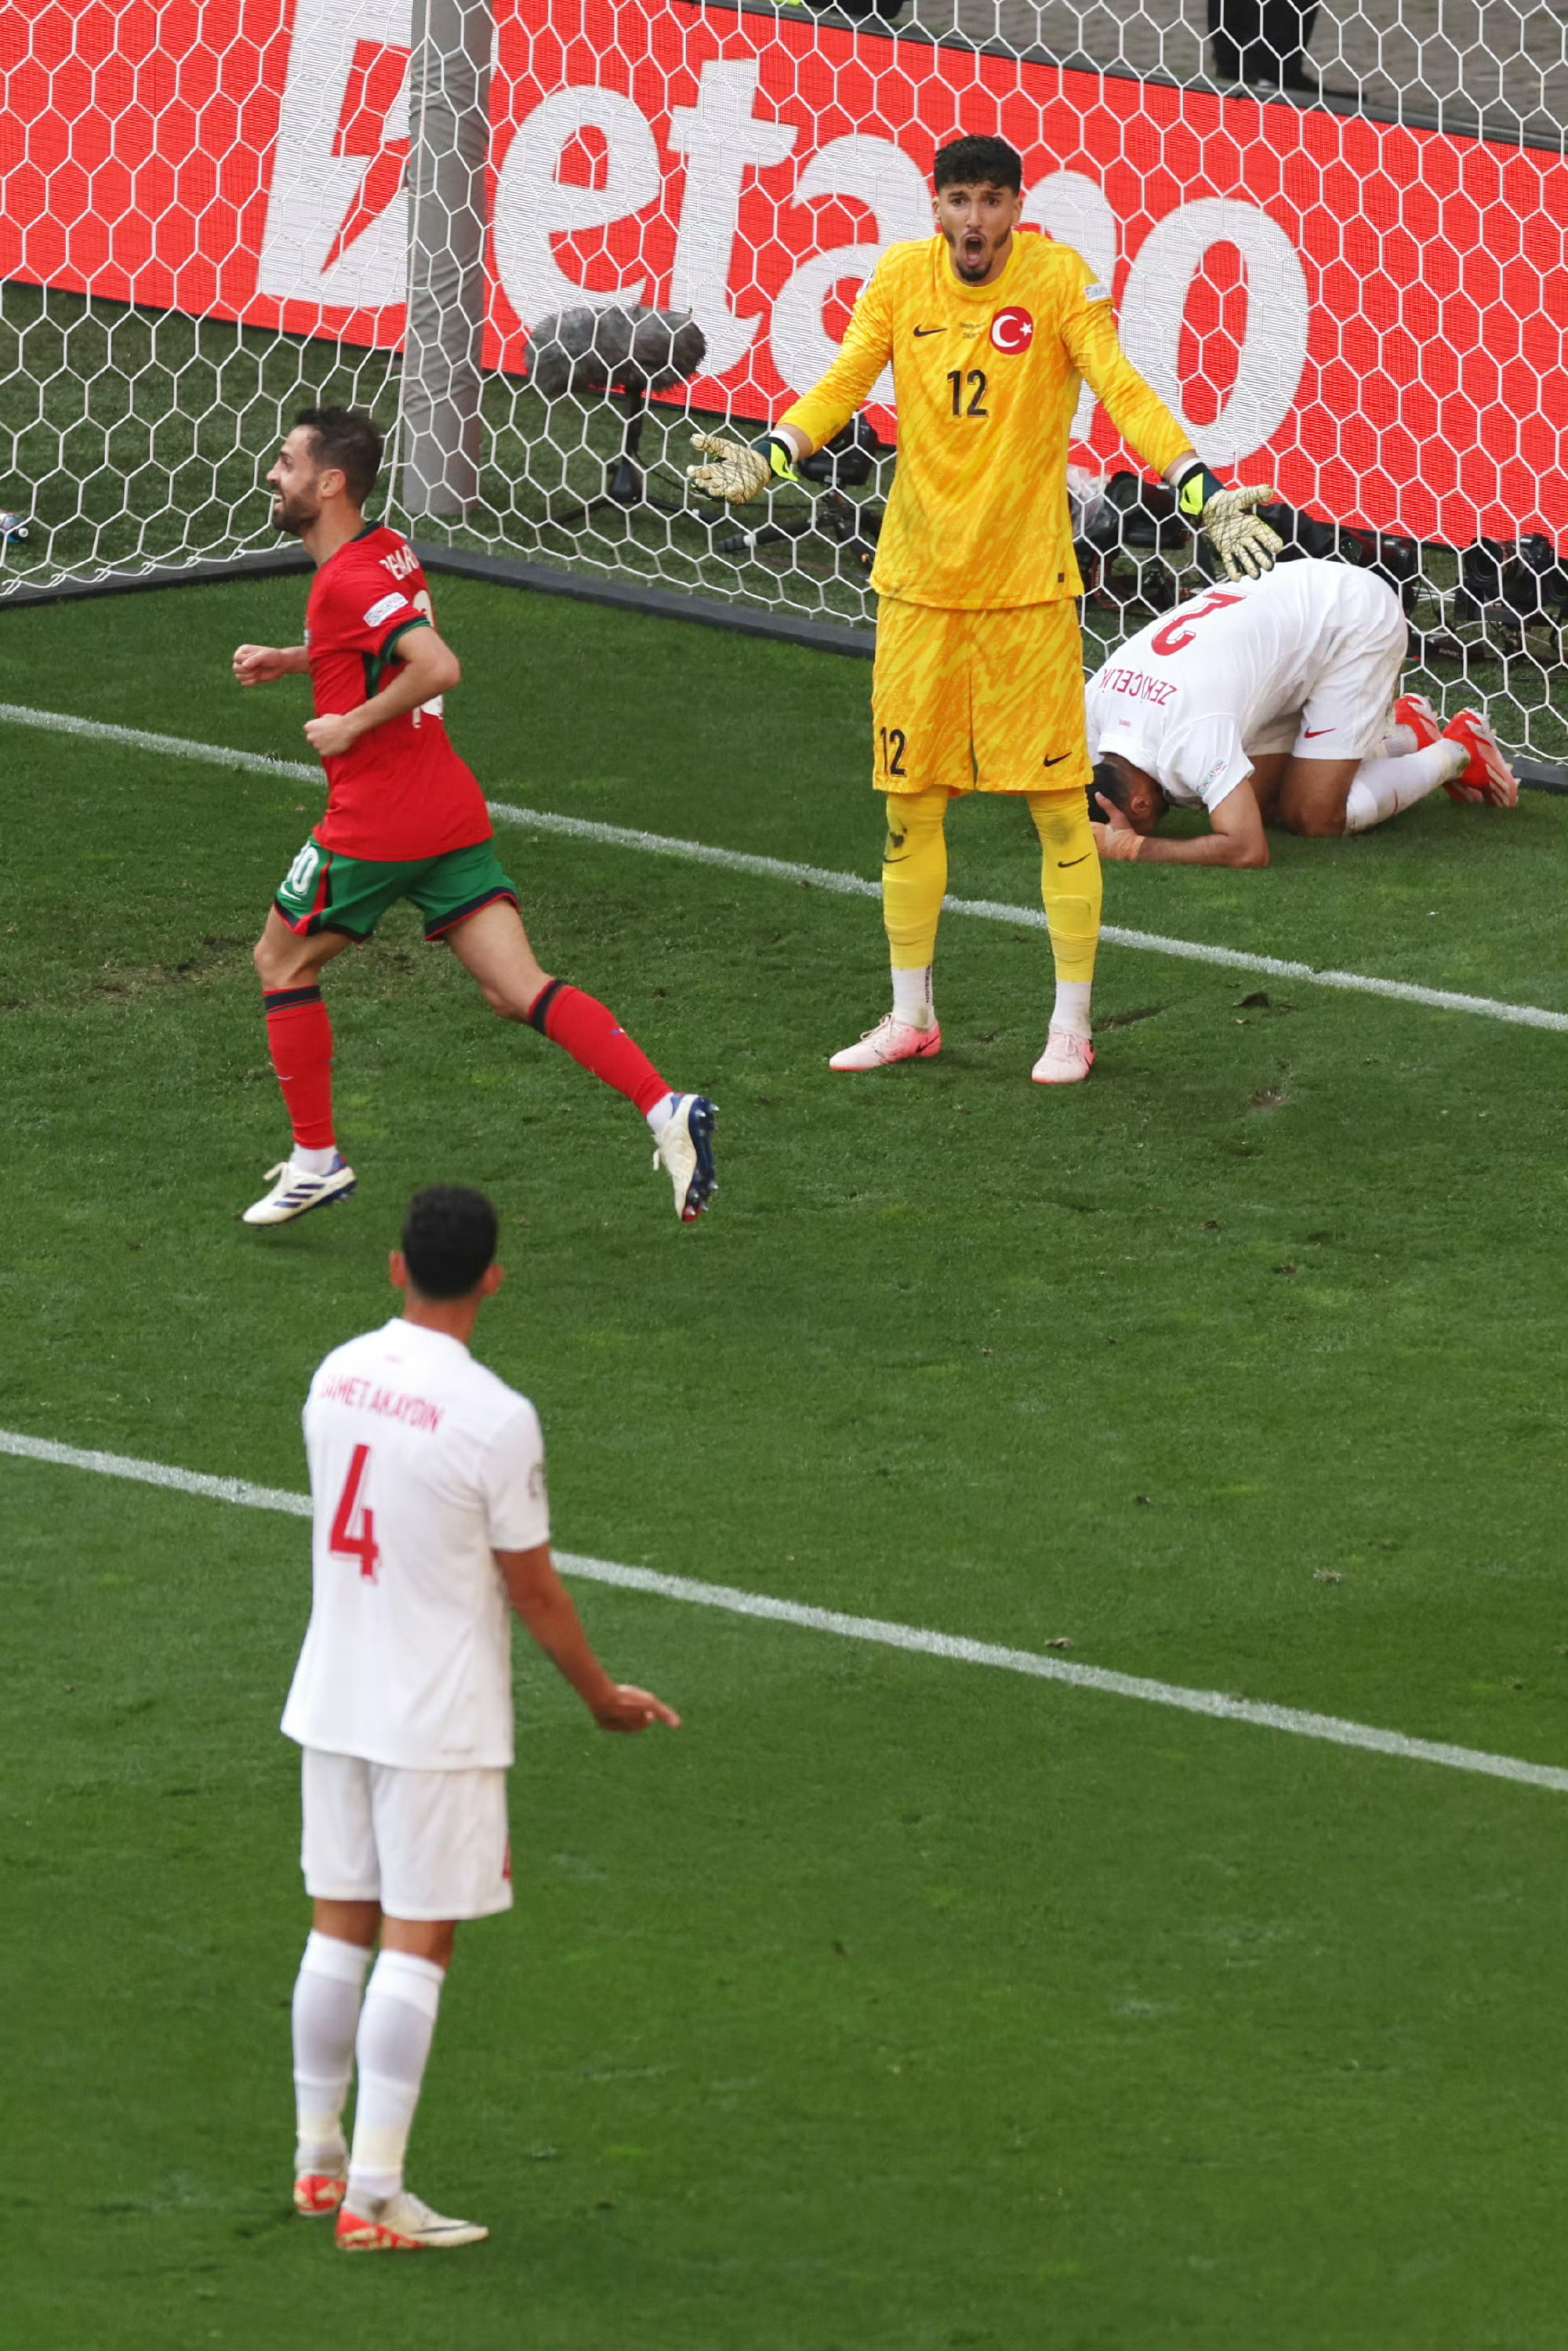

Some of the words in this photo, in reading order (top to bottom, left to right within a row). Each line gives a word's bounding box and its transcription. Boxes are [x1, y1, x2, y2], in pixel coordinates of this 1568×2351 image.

[946, 369, 988, 418] 12
[1151, 591, 1247, 656] 2
[880, 726, 907, 777] 12
[328, 1443, 382, 1585] 4
